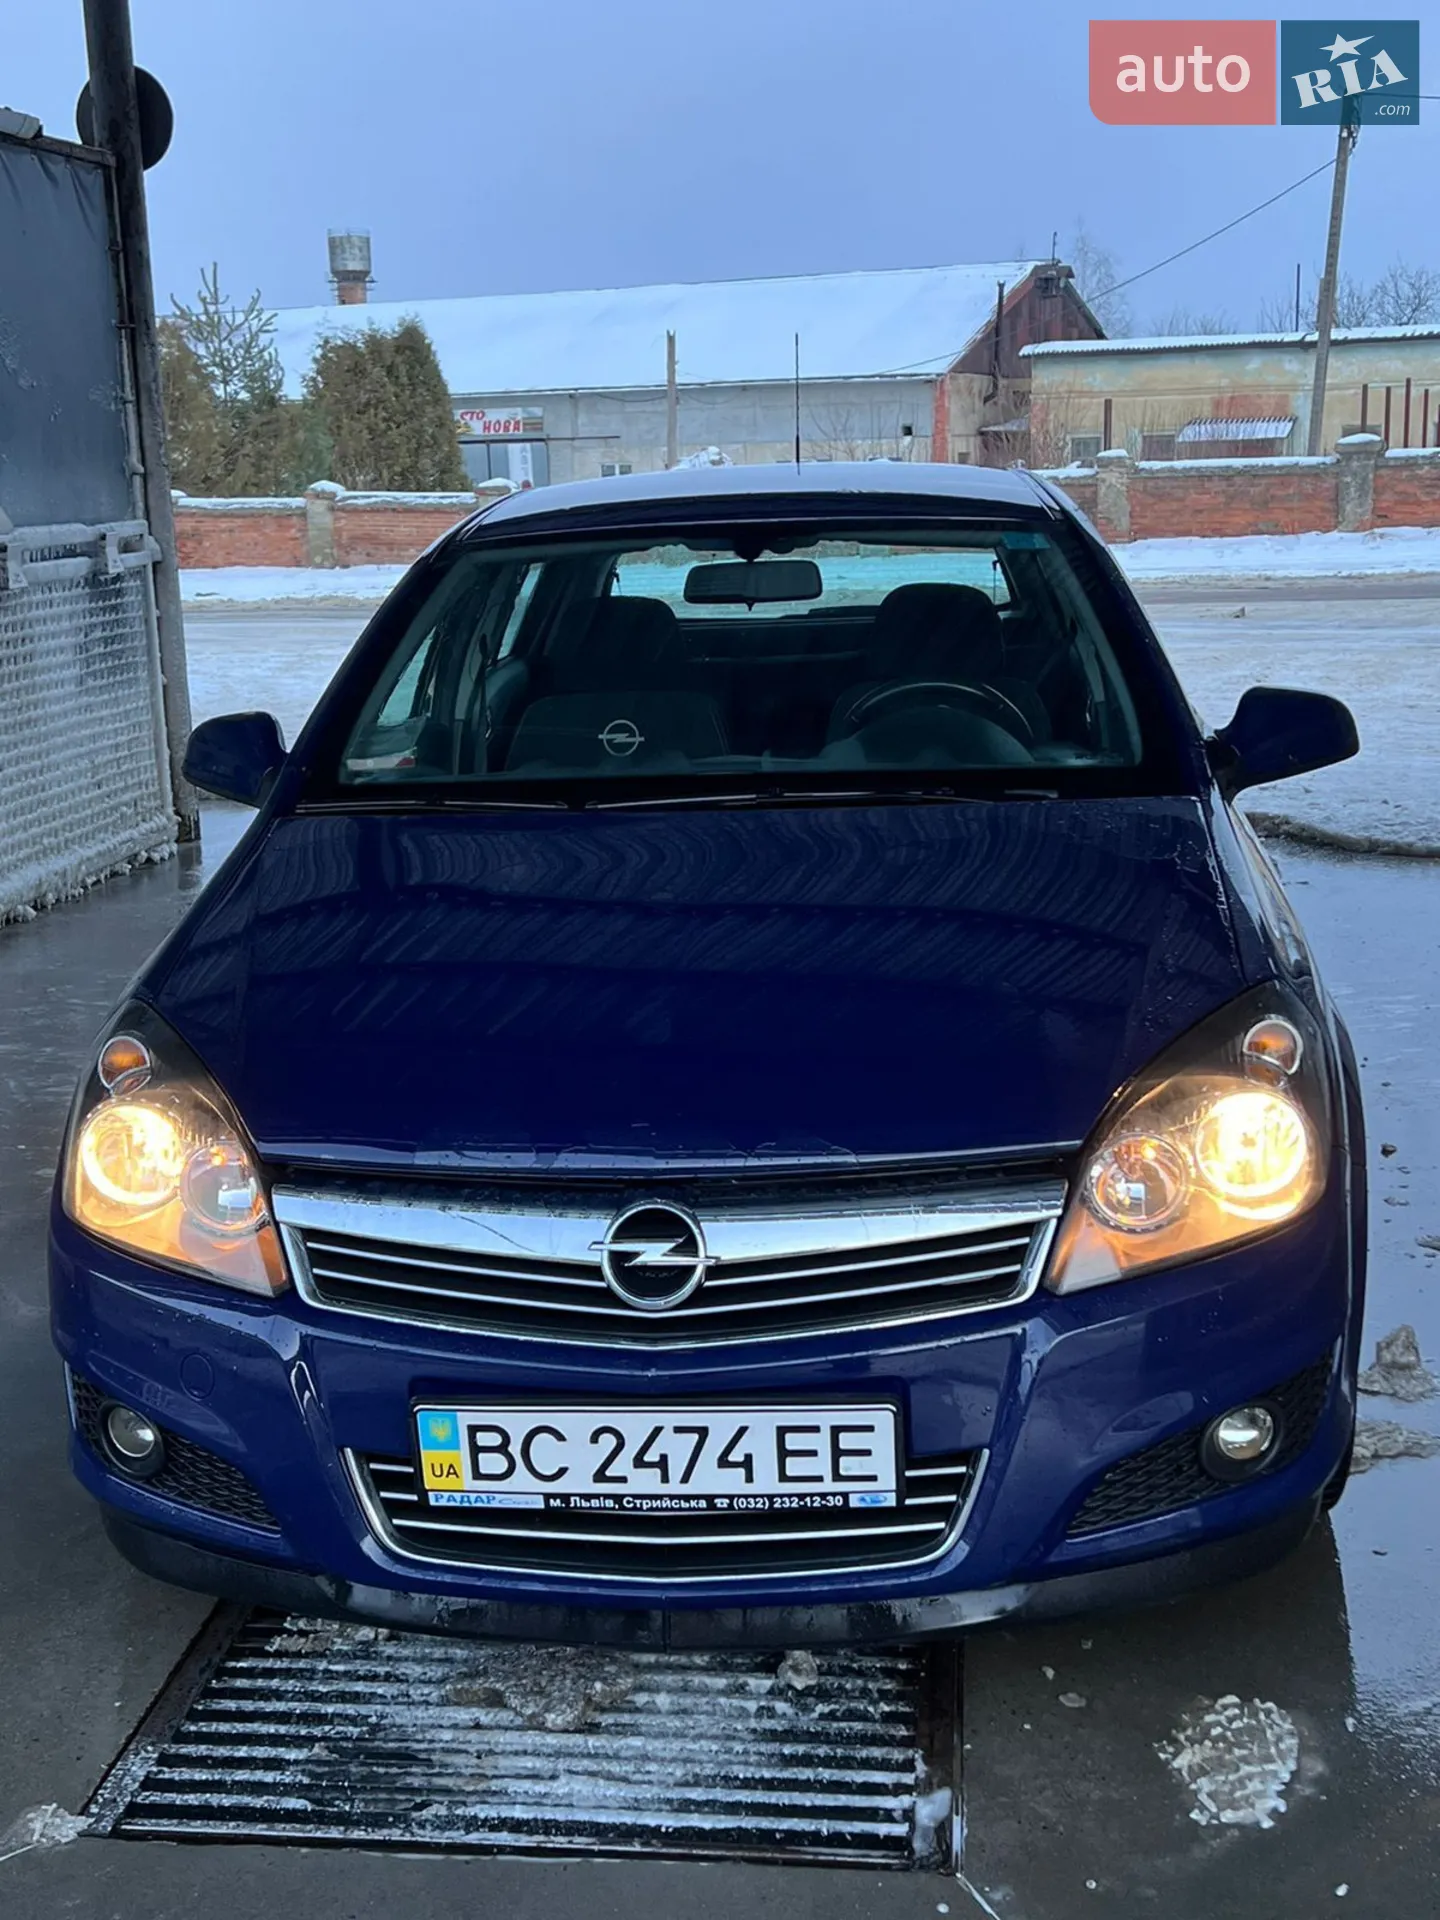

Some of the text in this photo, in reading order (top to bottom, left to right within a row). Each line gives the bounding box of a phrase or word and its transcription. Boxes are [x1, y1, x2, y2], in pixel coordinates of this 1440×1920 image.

[589, 1425, 754, 1484] 2474
[775, 1425, 878, 1483] EE
[430, 1464, 459, 1479] UA
[433, 1492, 497, 1506] РАДАР
[622, 1496, 707, 1510] Стрийська
[733, 1497, 769, 1510] (032)
[773, 1495, 844, 1509] 232-12-30
